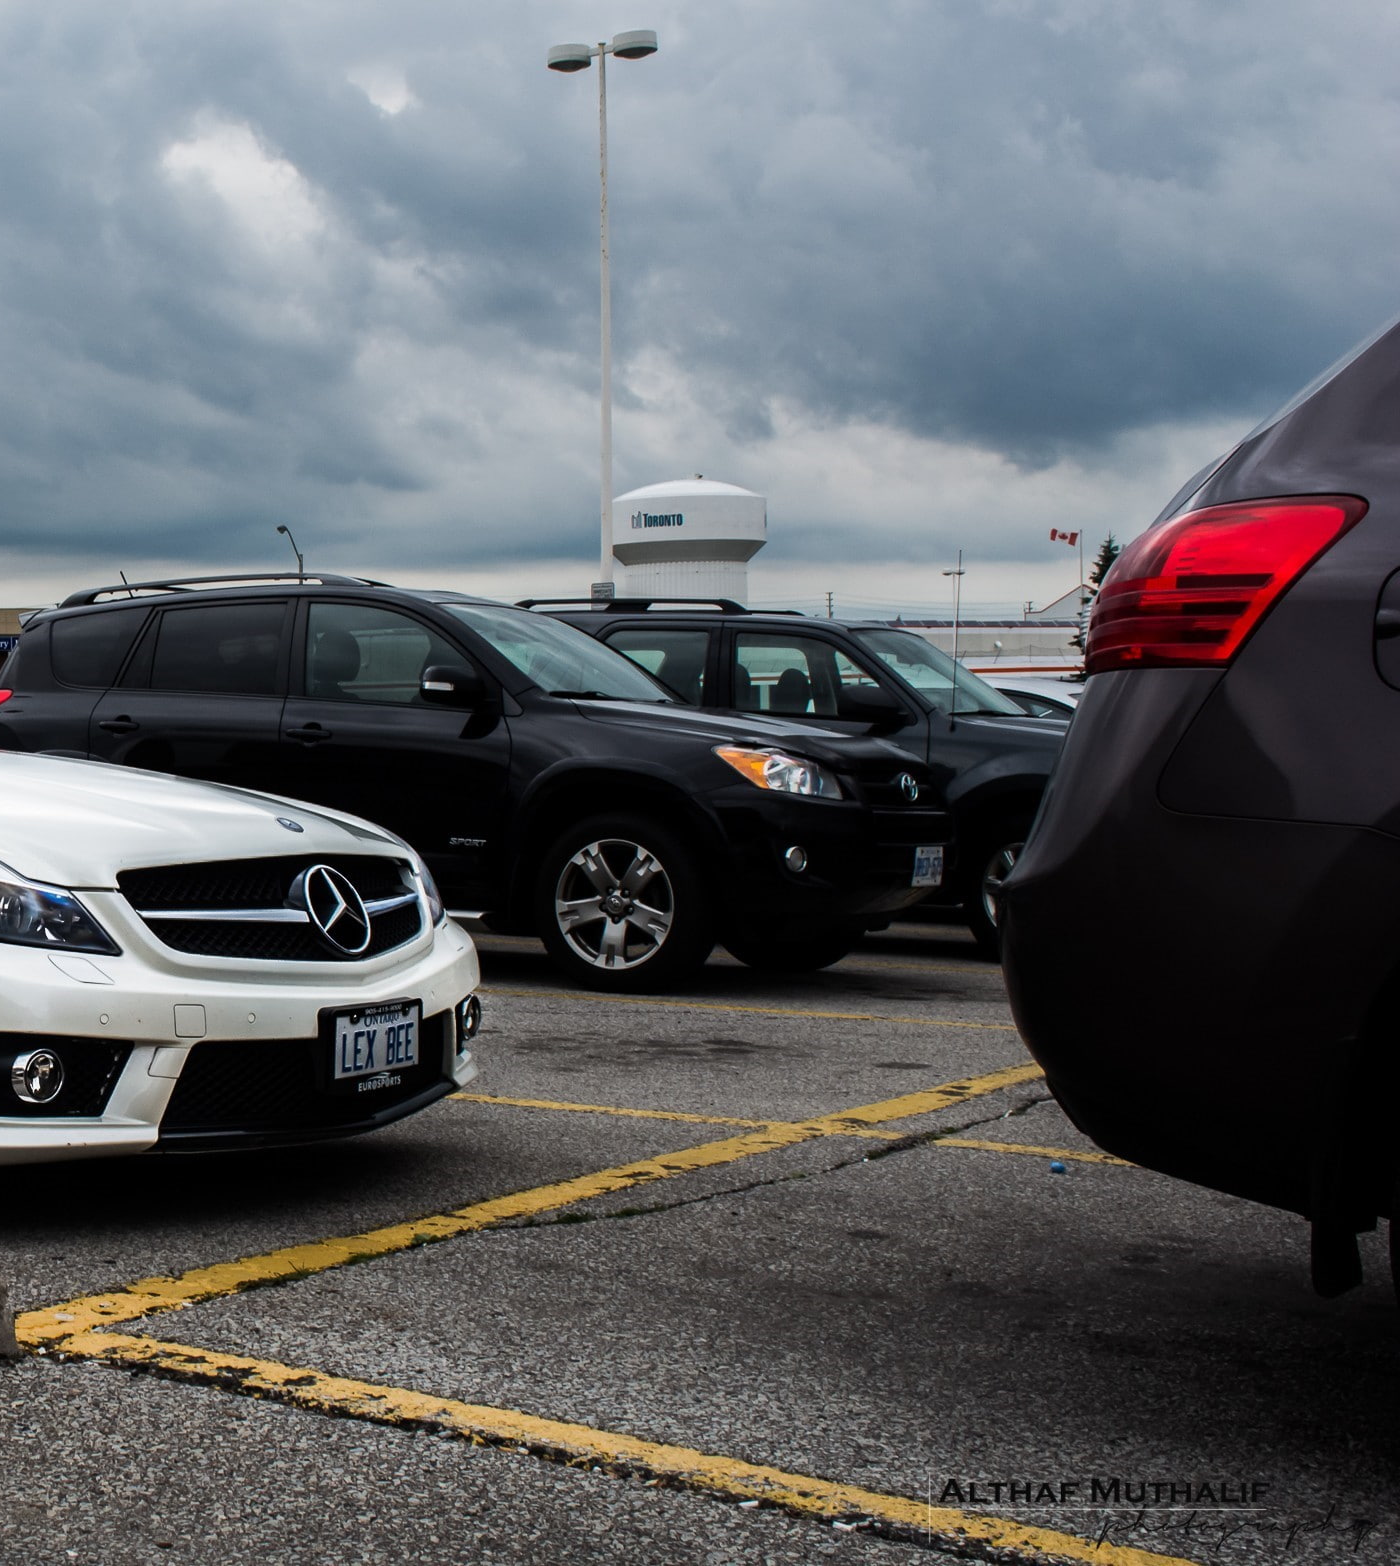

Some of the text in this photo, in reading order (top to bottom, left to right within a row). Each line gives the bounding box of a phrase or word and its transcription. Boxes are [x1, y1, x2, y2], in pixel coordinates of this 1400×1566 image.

[642, 513, 683, 528] TORONTO
[449, 837, 487, 847] SPORT
[342, 1023, 414, 1073] LEX BEE
[358, 1075, 401, 1092] EUROSPORTS
